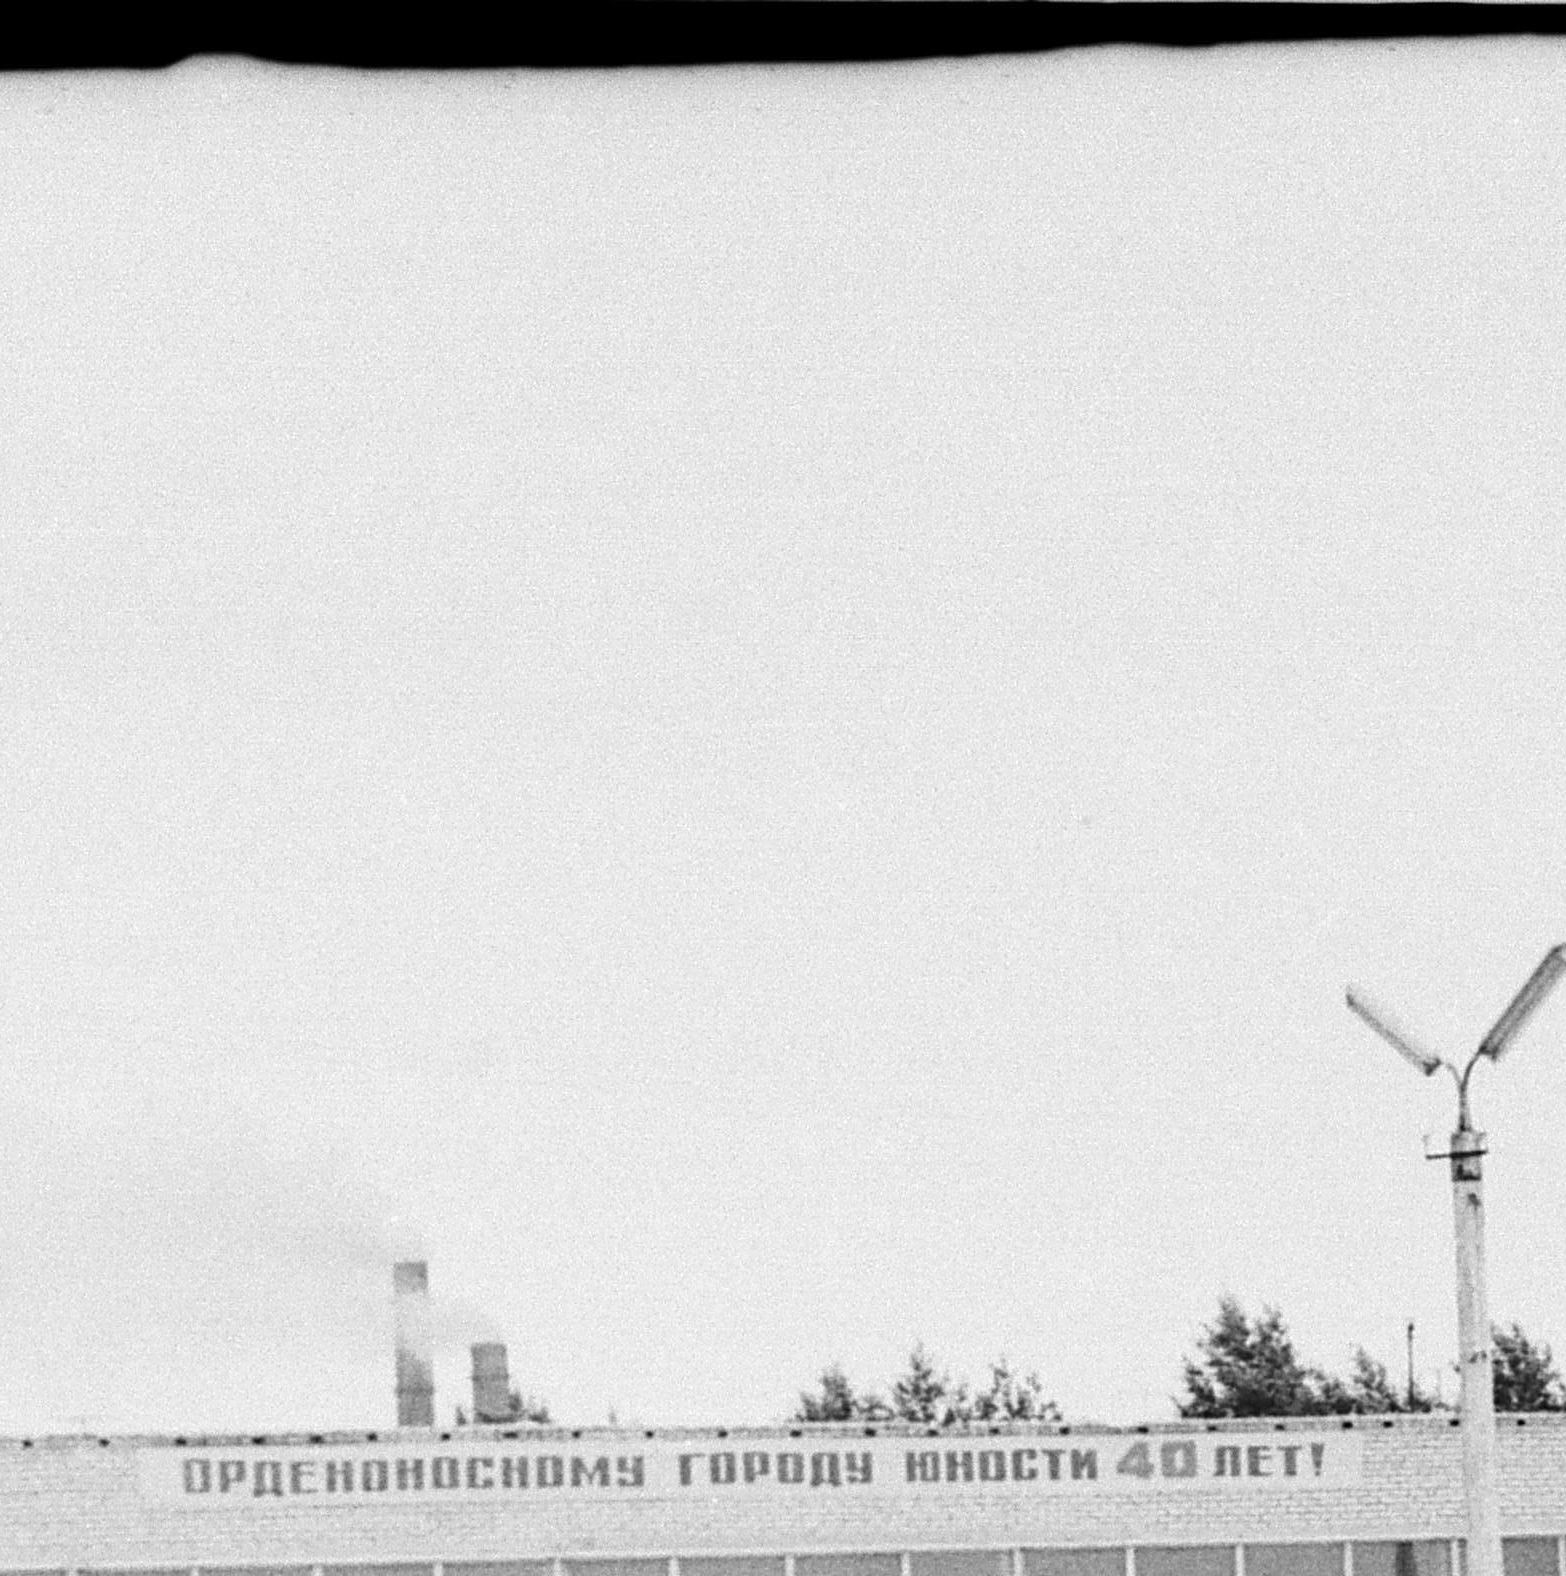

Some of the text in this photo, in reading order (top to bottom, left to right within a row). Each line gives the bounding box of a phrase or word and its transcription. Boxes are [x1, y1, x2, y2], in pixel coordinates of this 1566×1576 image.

[182, 1439, 1325, 1497] ОРДЕНОНОСНОМУ ГОРОДУ ЮНОСТИ 40 ЛЕТ!
